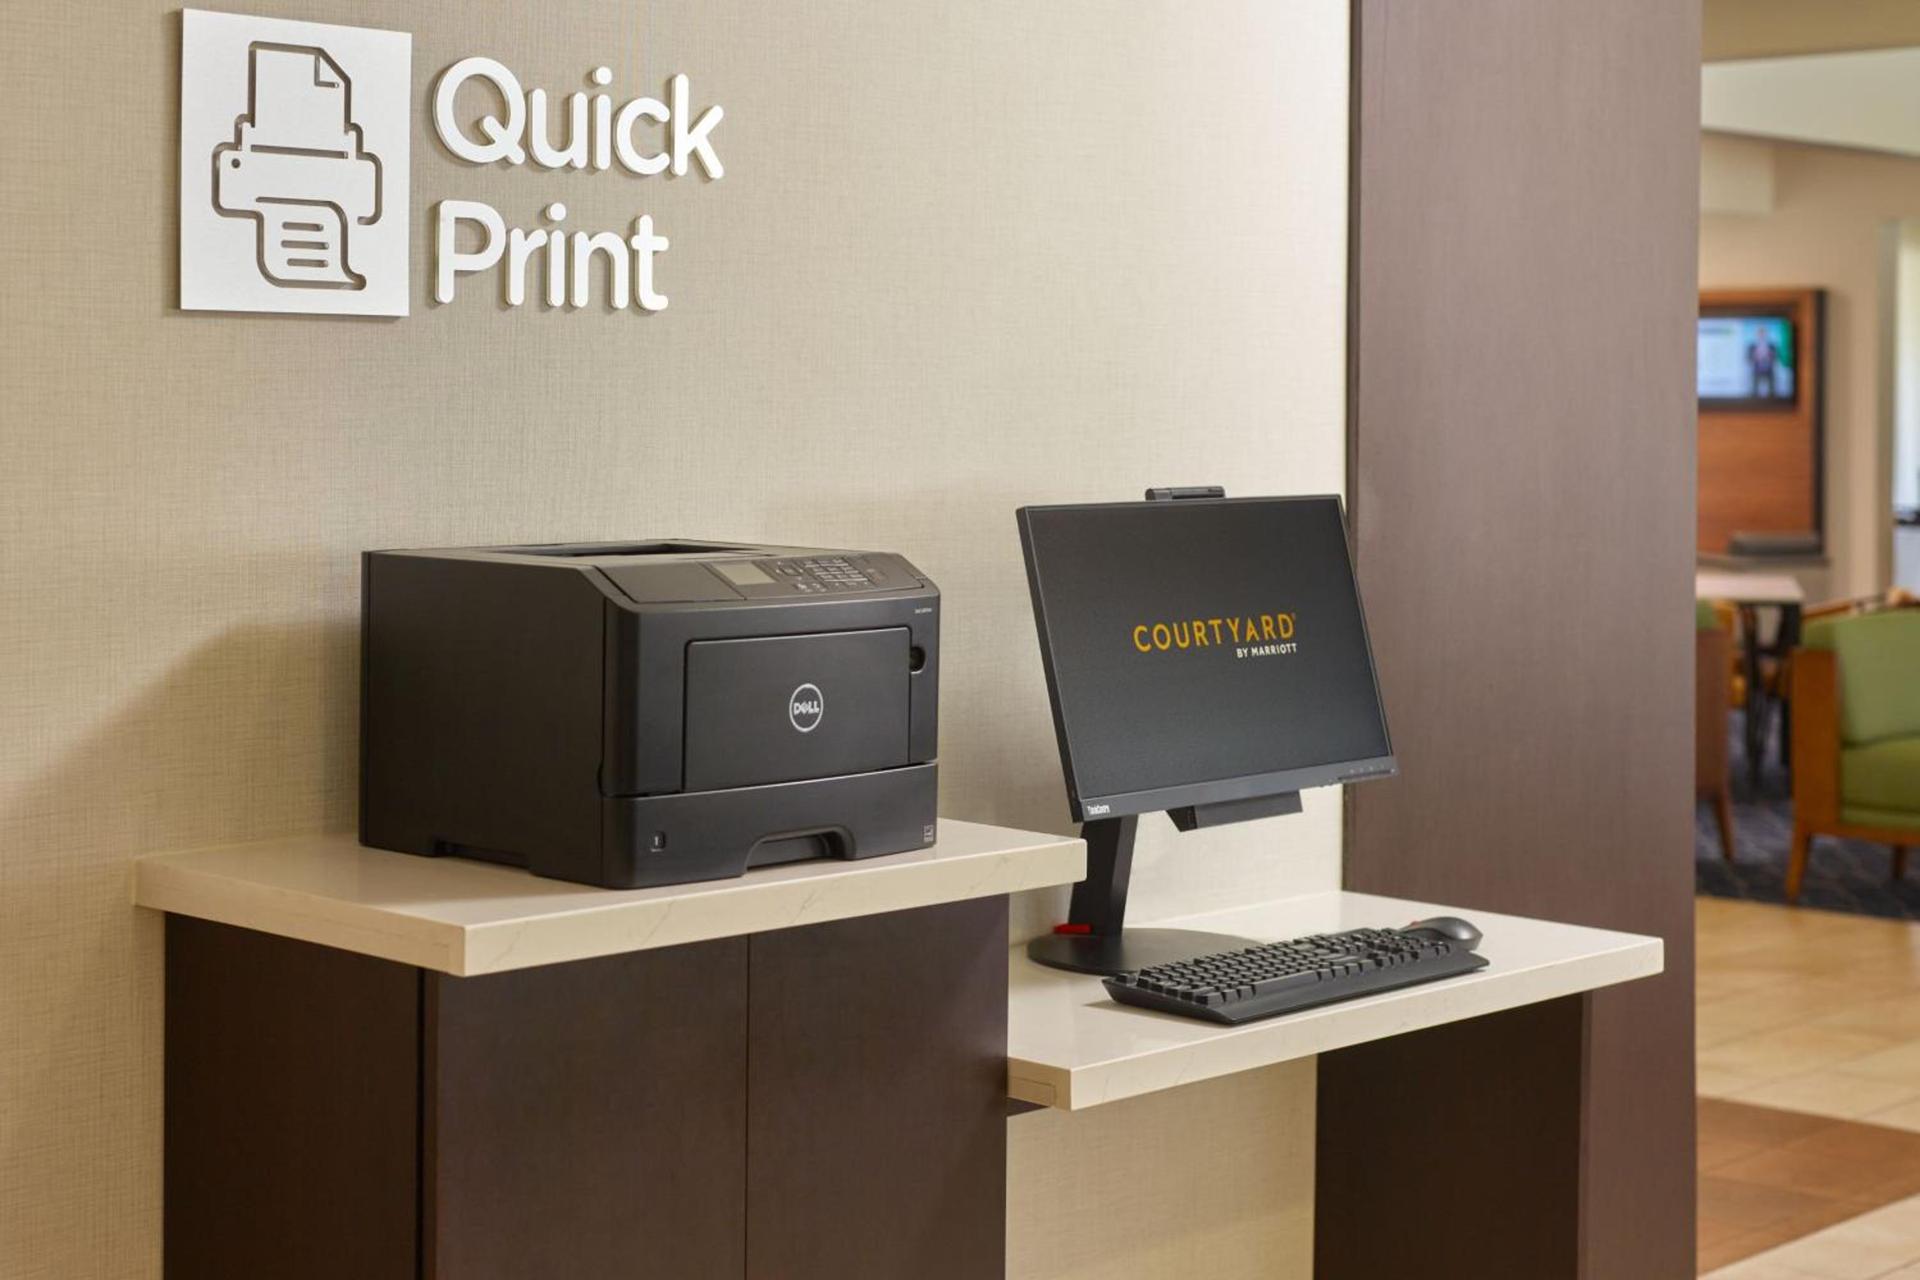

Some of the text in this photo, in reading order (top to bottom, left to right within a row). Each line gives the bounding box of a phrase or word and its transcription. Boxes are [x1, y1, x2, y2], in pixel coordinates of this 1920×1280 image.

[433, 57, 724, 180] Quick
[434, 200, 669, 311] Print
[1133, 613, 1295, 652] COURTYARD
[1236, 643, 1297, 658] BY MARRIOTT
[793, 700, 820, 715] DELL
